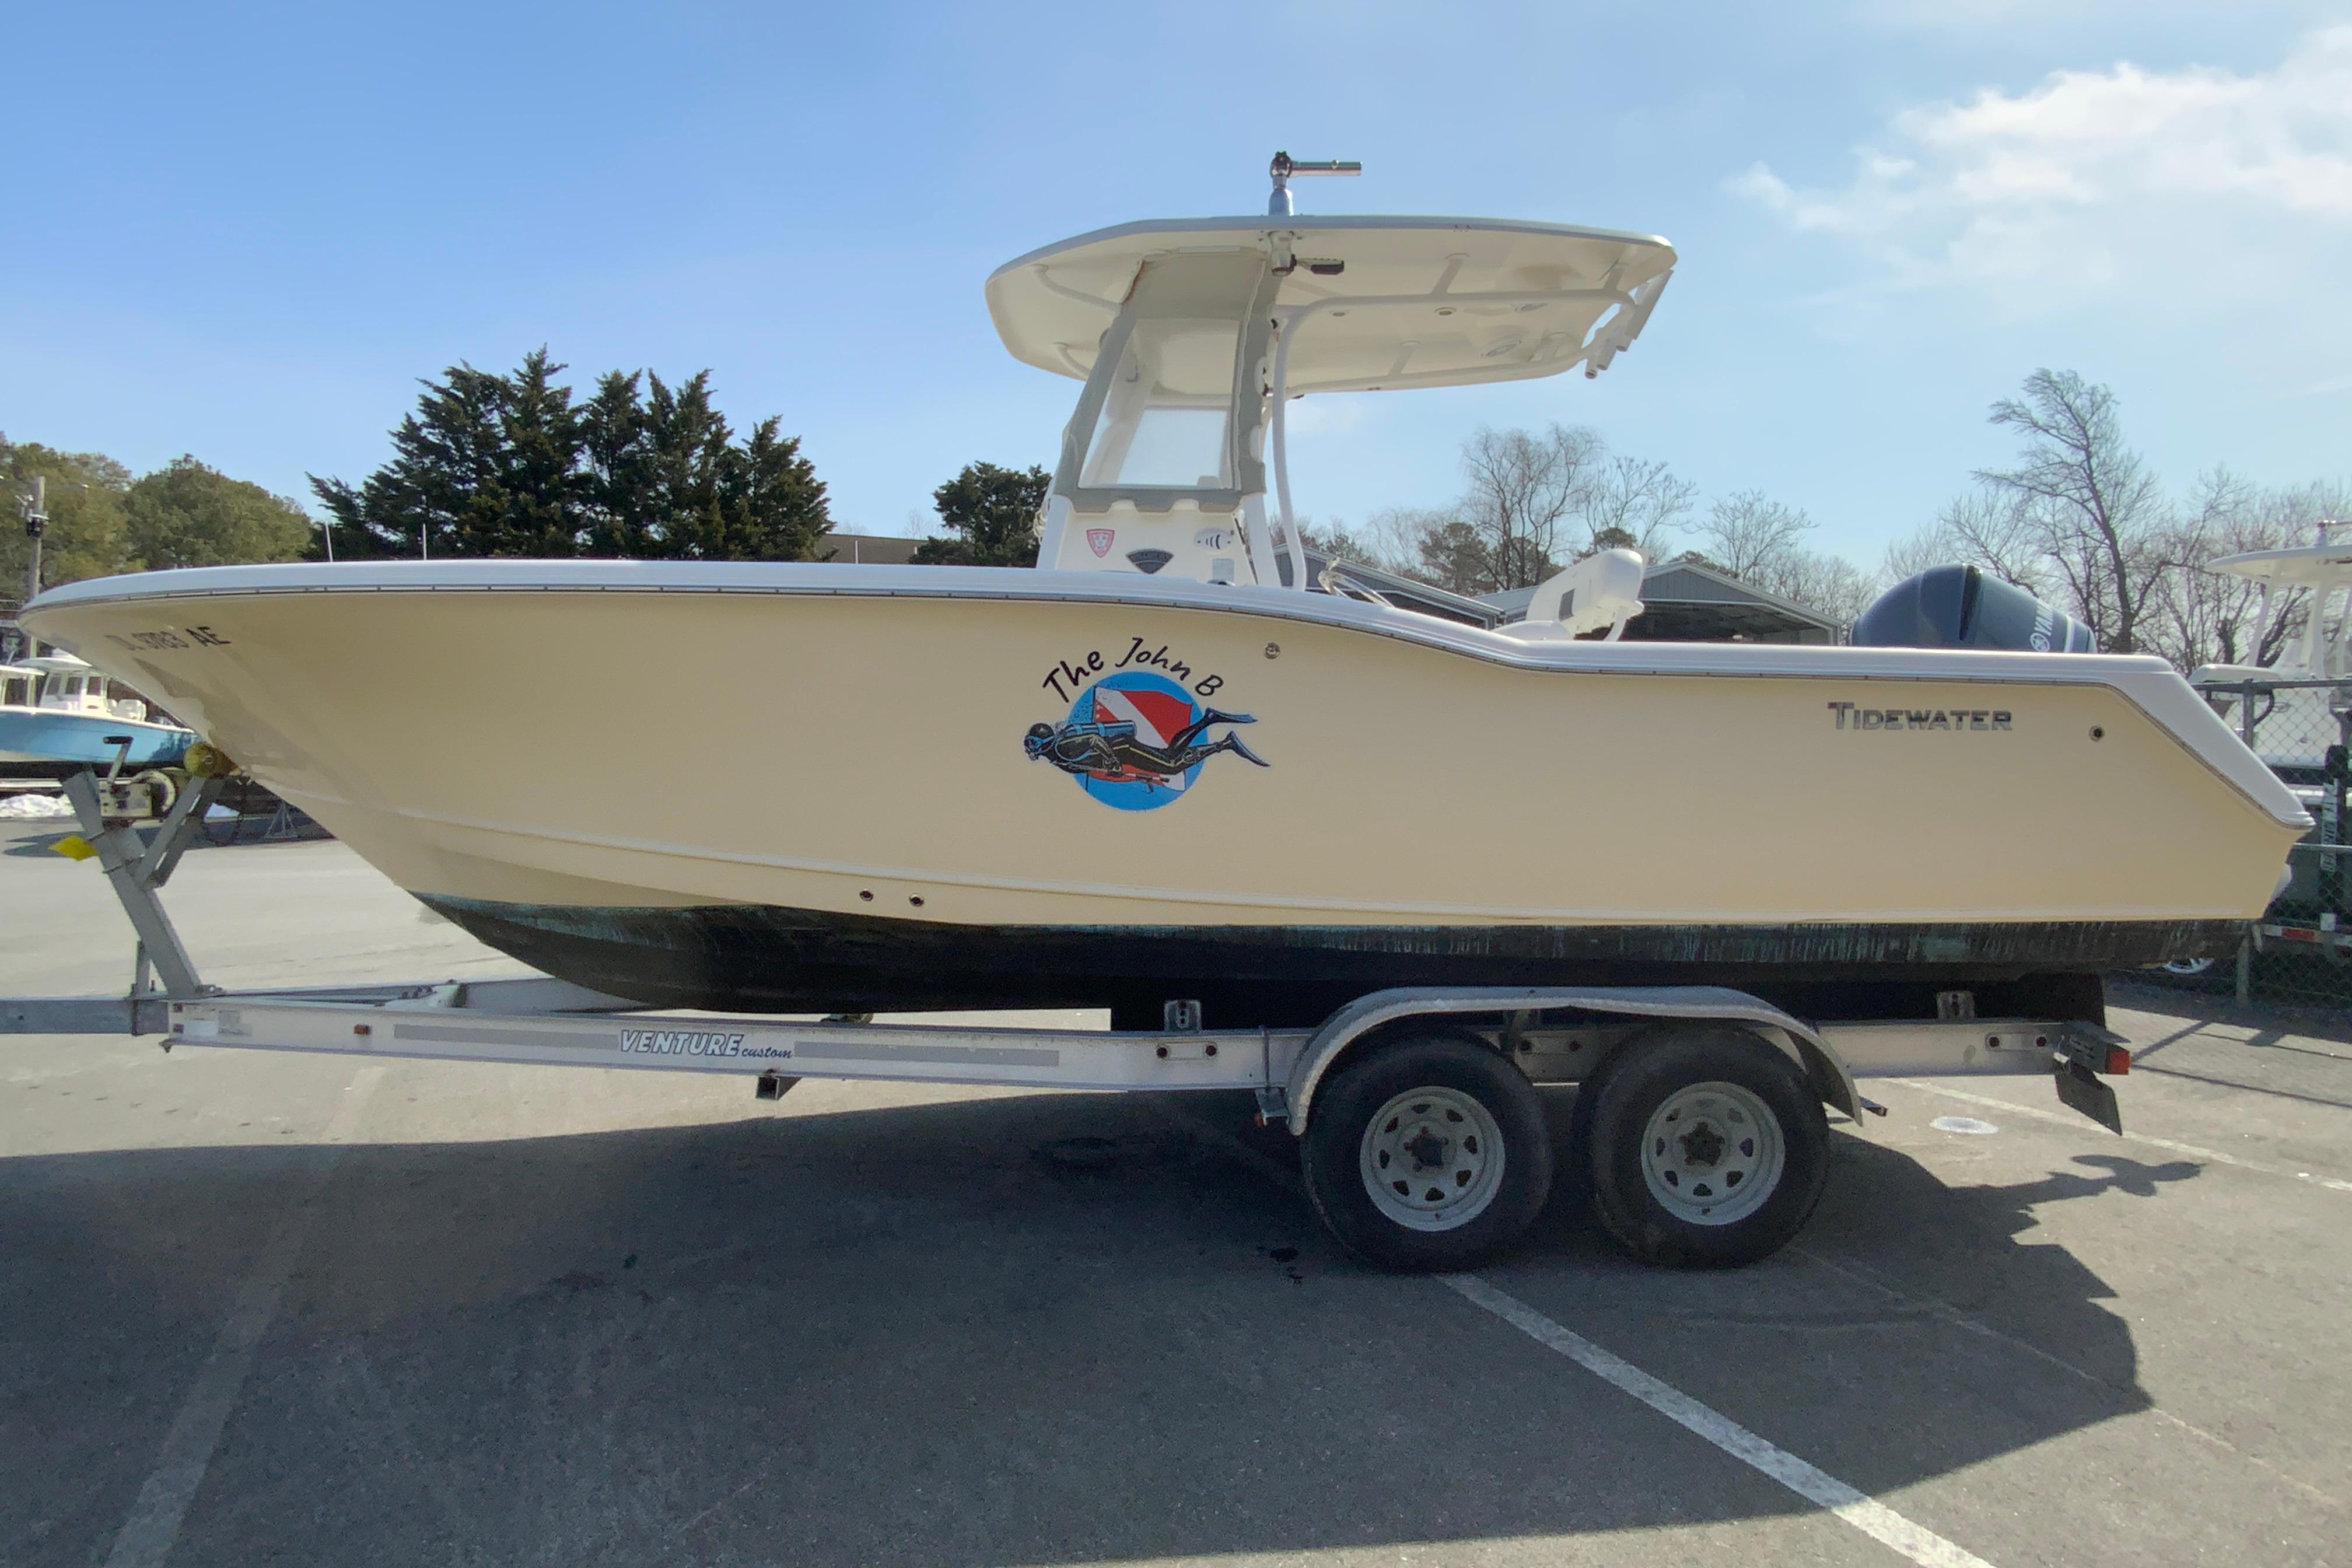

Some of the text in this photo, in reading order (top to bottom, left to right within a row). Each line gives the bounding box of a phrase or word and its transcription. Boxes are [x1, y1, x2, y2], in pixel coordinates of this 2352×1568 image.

[185, 626, 232, 648] AE
[1042, 637, 1224, 703] The John B
[1828, 701, 2013, 730] TIDEWATER
[621, 1029, 793, 1059] VENTURE custom
